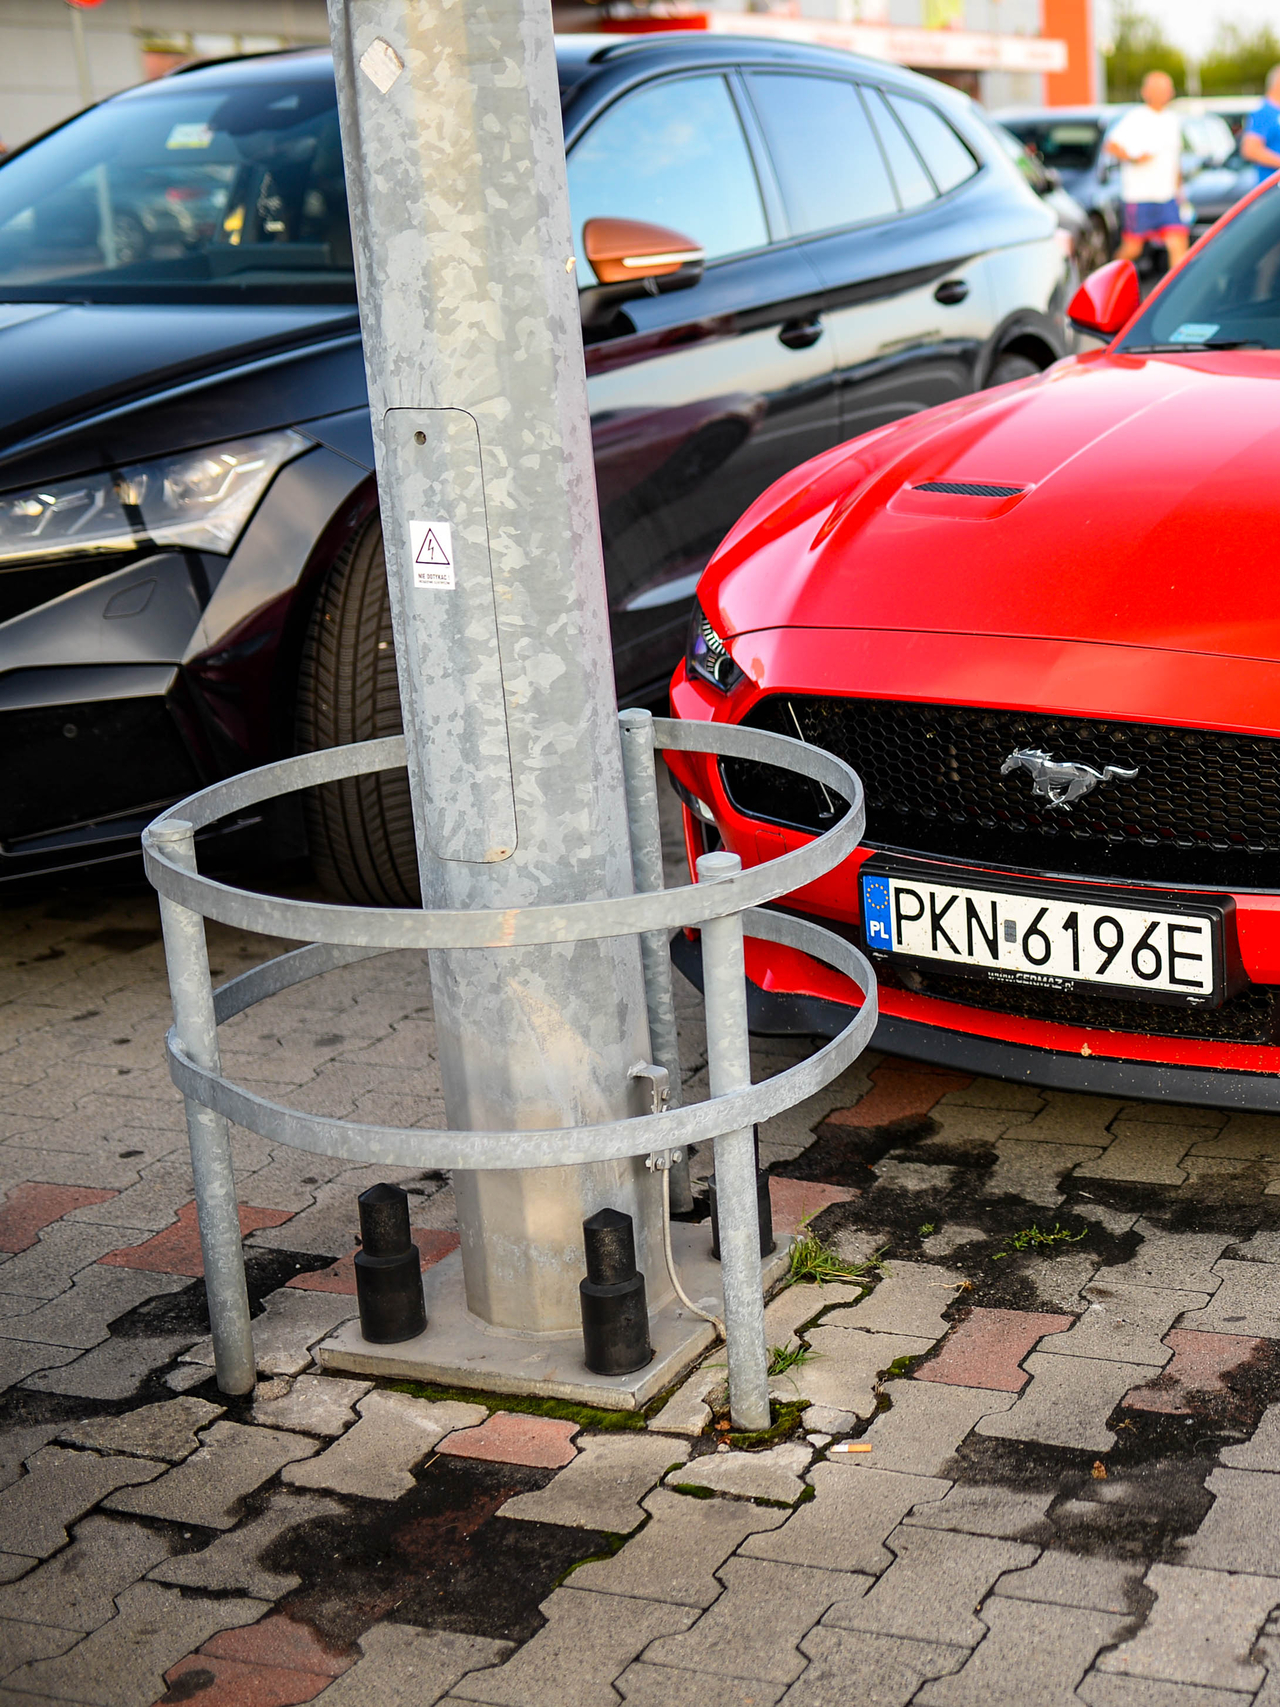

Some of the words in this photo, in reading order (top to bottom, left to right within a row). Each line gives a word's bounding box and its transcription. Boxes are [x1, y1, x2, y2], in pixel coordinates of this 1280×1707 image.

[870, 919, 890, 939] PL
[893, 886, 1000, 961] PKN
[1022, 907, 1204, 989] 6196E
[987, 971, 1075, 992] www.GERMAZ.pl
